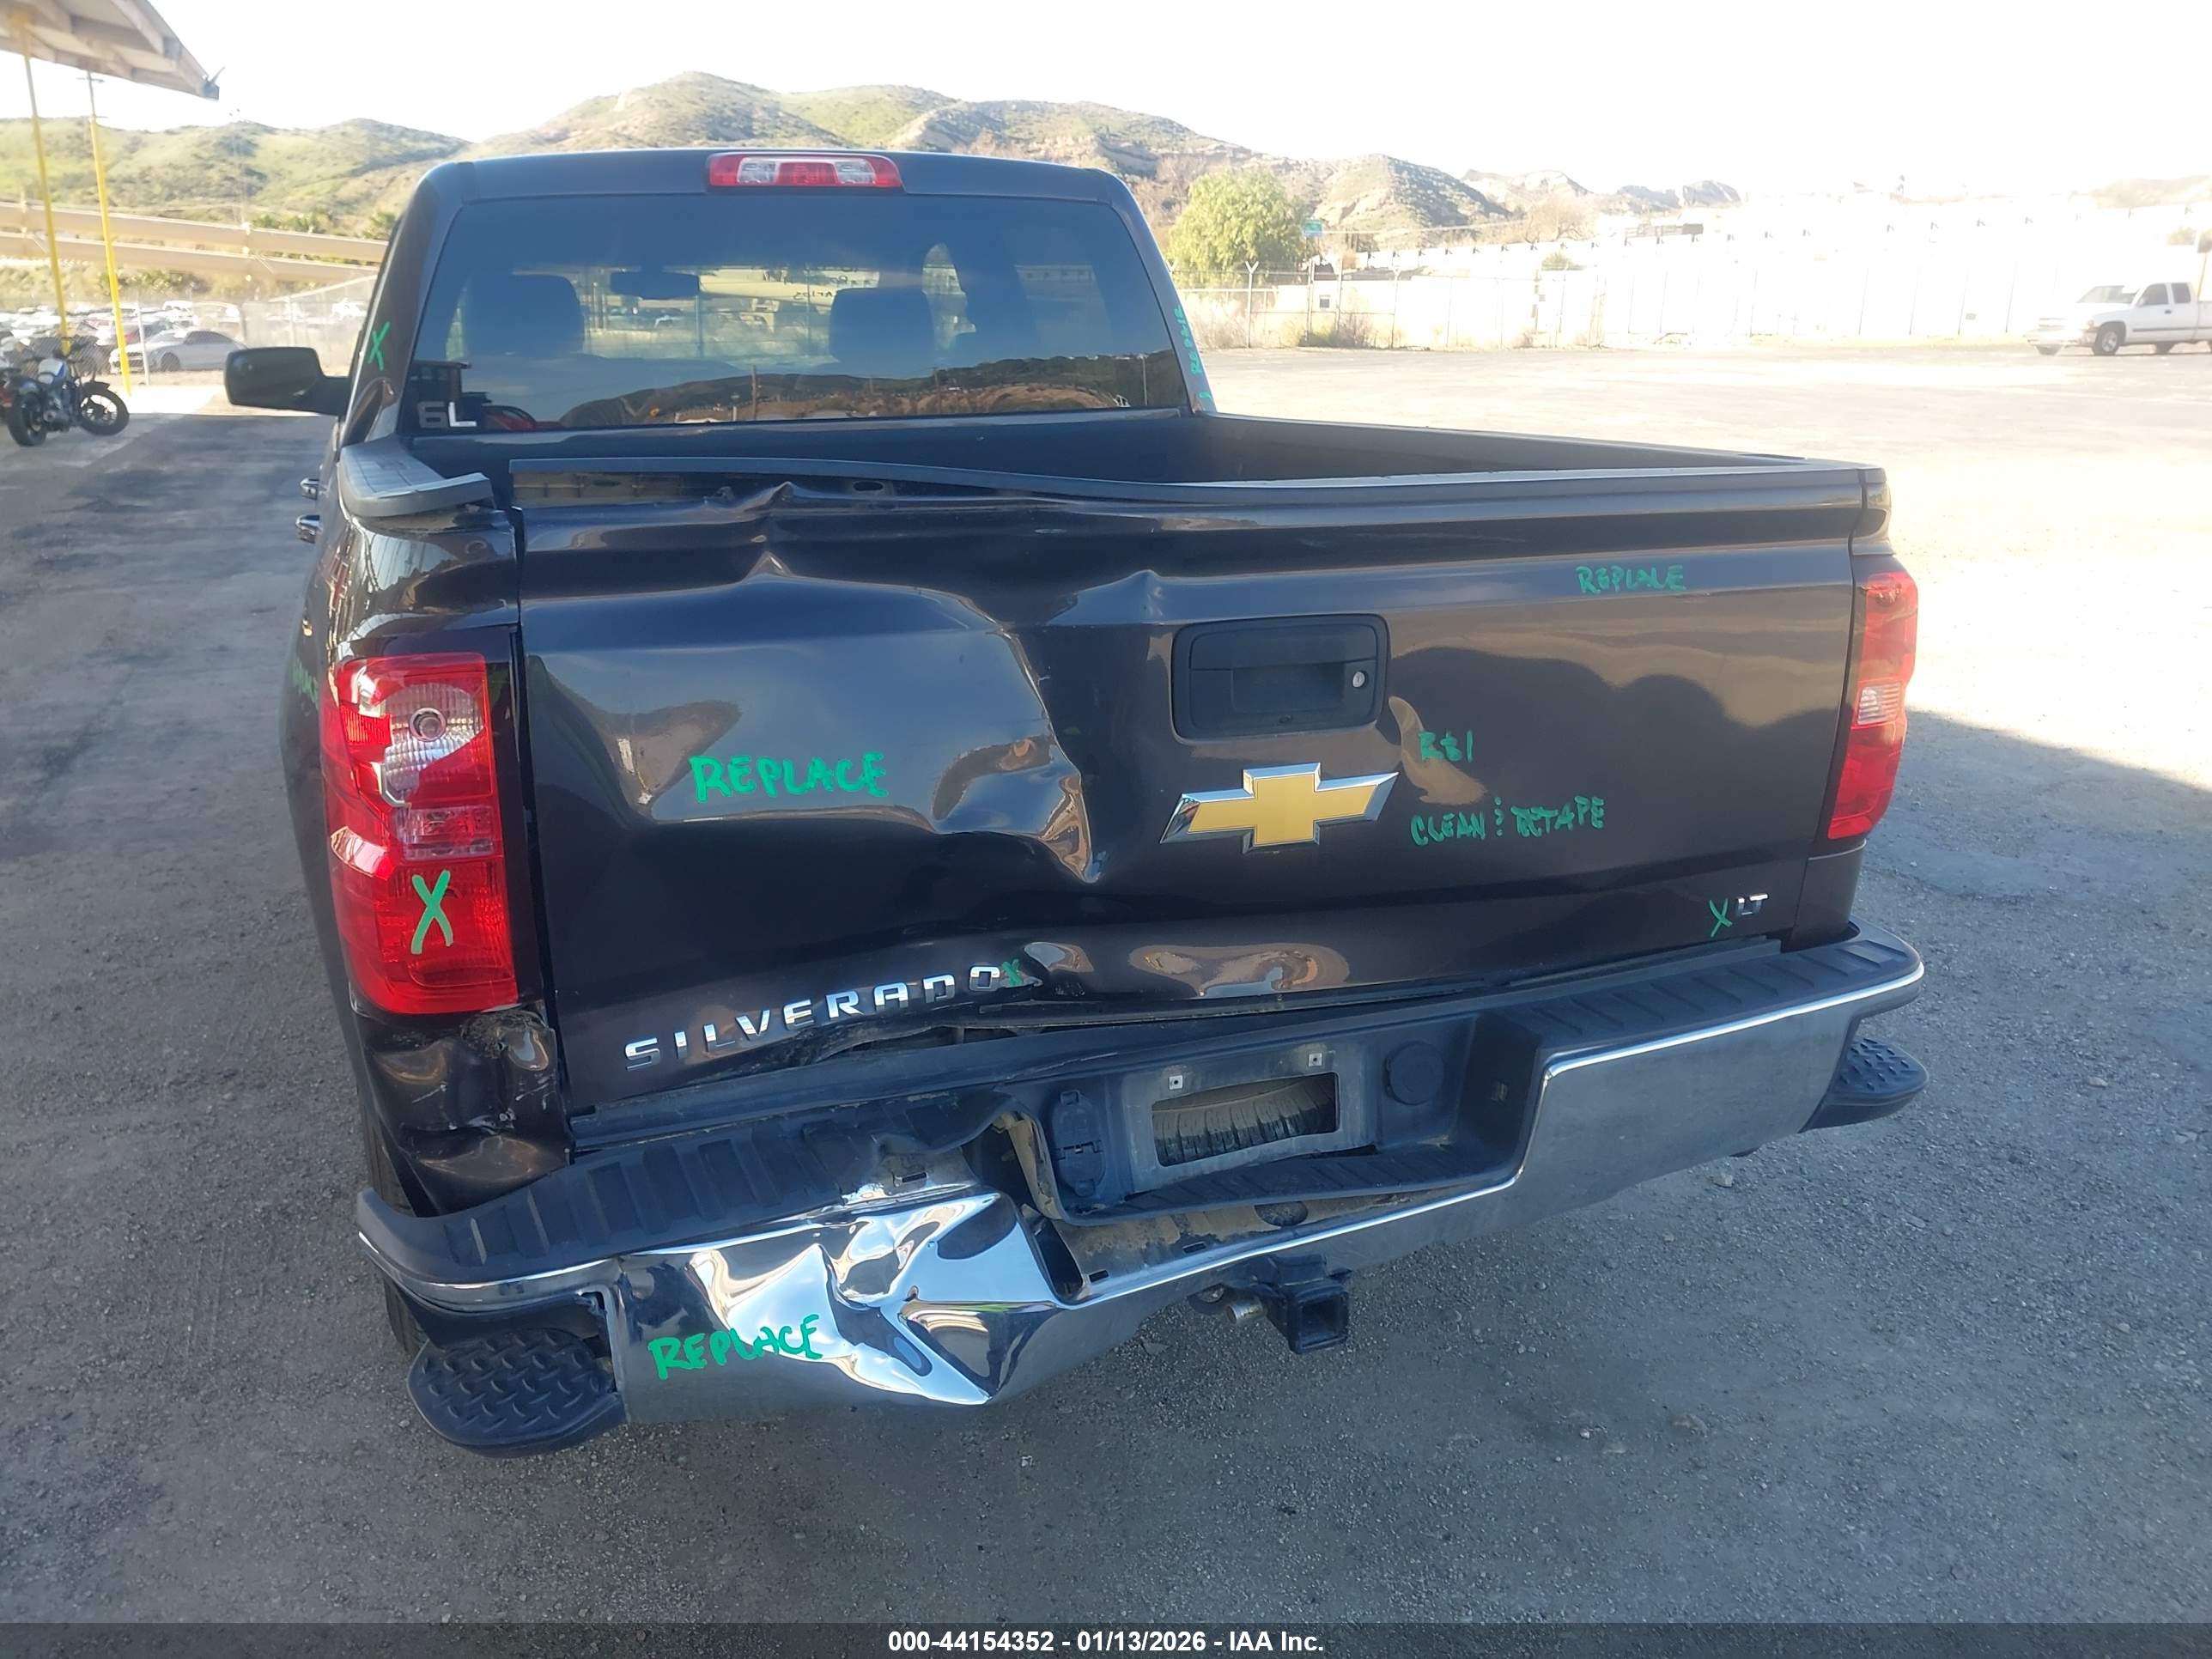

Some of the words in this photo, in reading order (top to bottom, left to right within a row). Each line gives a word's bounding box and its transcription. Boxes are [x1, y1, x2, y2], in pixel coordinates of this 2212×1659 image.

[687, 750, 889, 804] REPLACE
[1410, 811, 1486, 846] CLEAN
[1735, 892, 1770, 917] LT
[623, 964, 1001, 1072] SILVERADO
[646, 1313, 824, 1382] REPLACE
